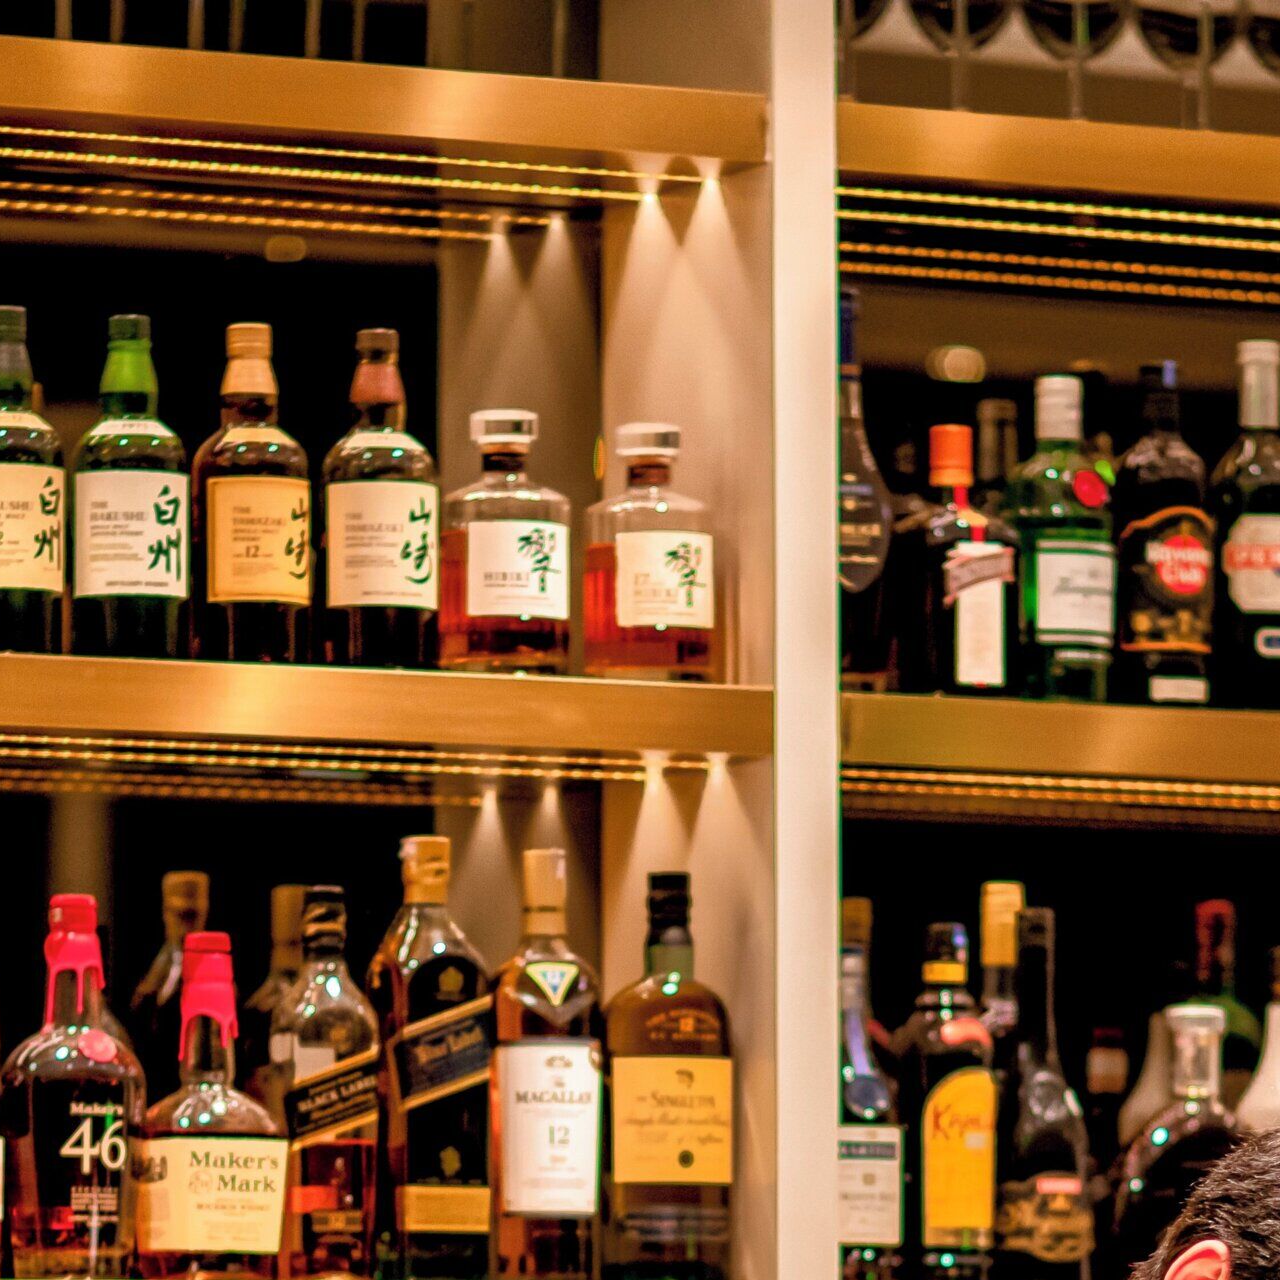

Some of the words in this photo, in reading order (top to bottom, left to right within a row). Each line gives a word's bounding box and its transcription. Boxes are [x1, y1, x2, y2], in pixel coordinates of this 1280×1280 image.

[147, 484, 182, 582] 白州
[245, 545, 260, 558] 12
[70, 1103, 124, 1116] Maker's
[548, 1125, 570, 1145] 12
[59, 1117, 127, 1175] 46
[190, 1151, 279, 1169] Maker's
[217, 1174, 277, 1193] Mark
